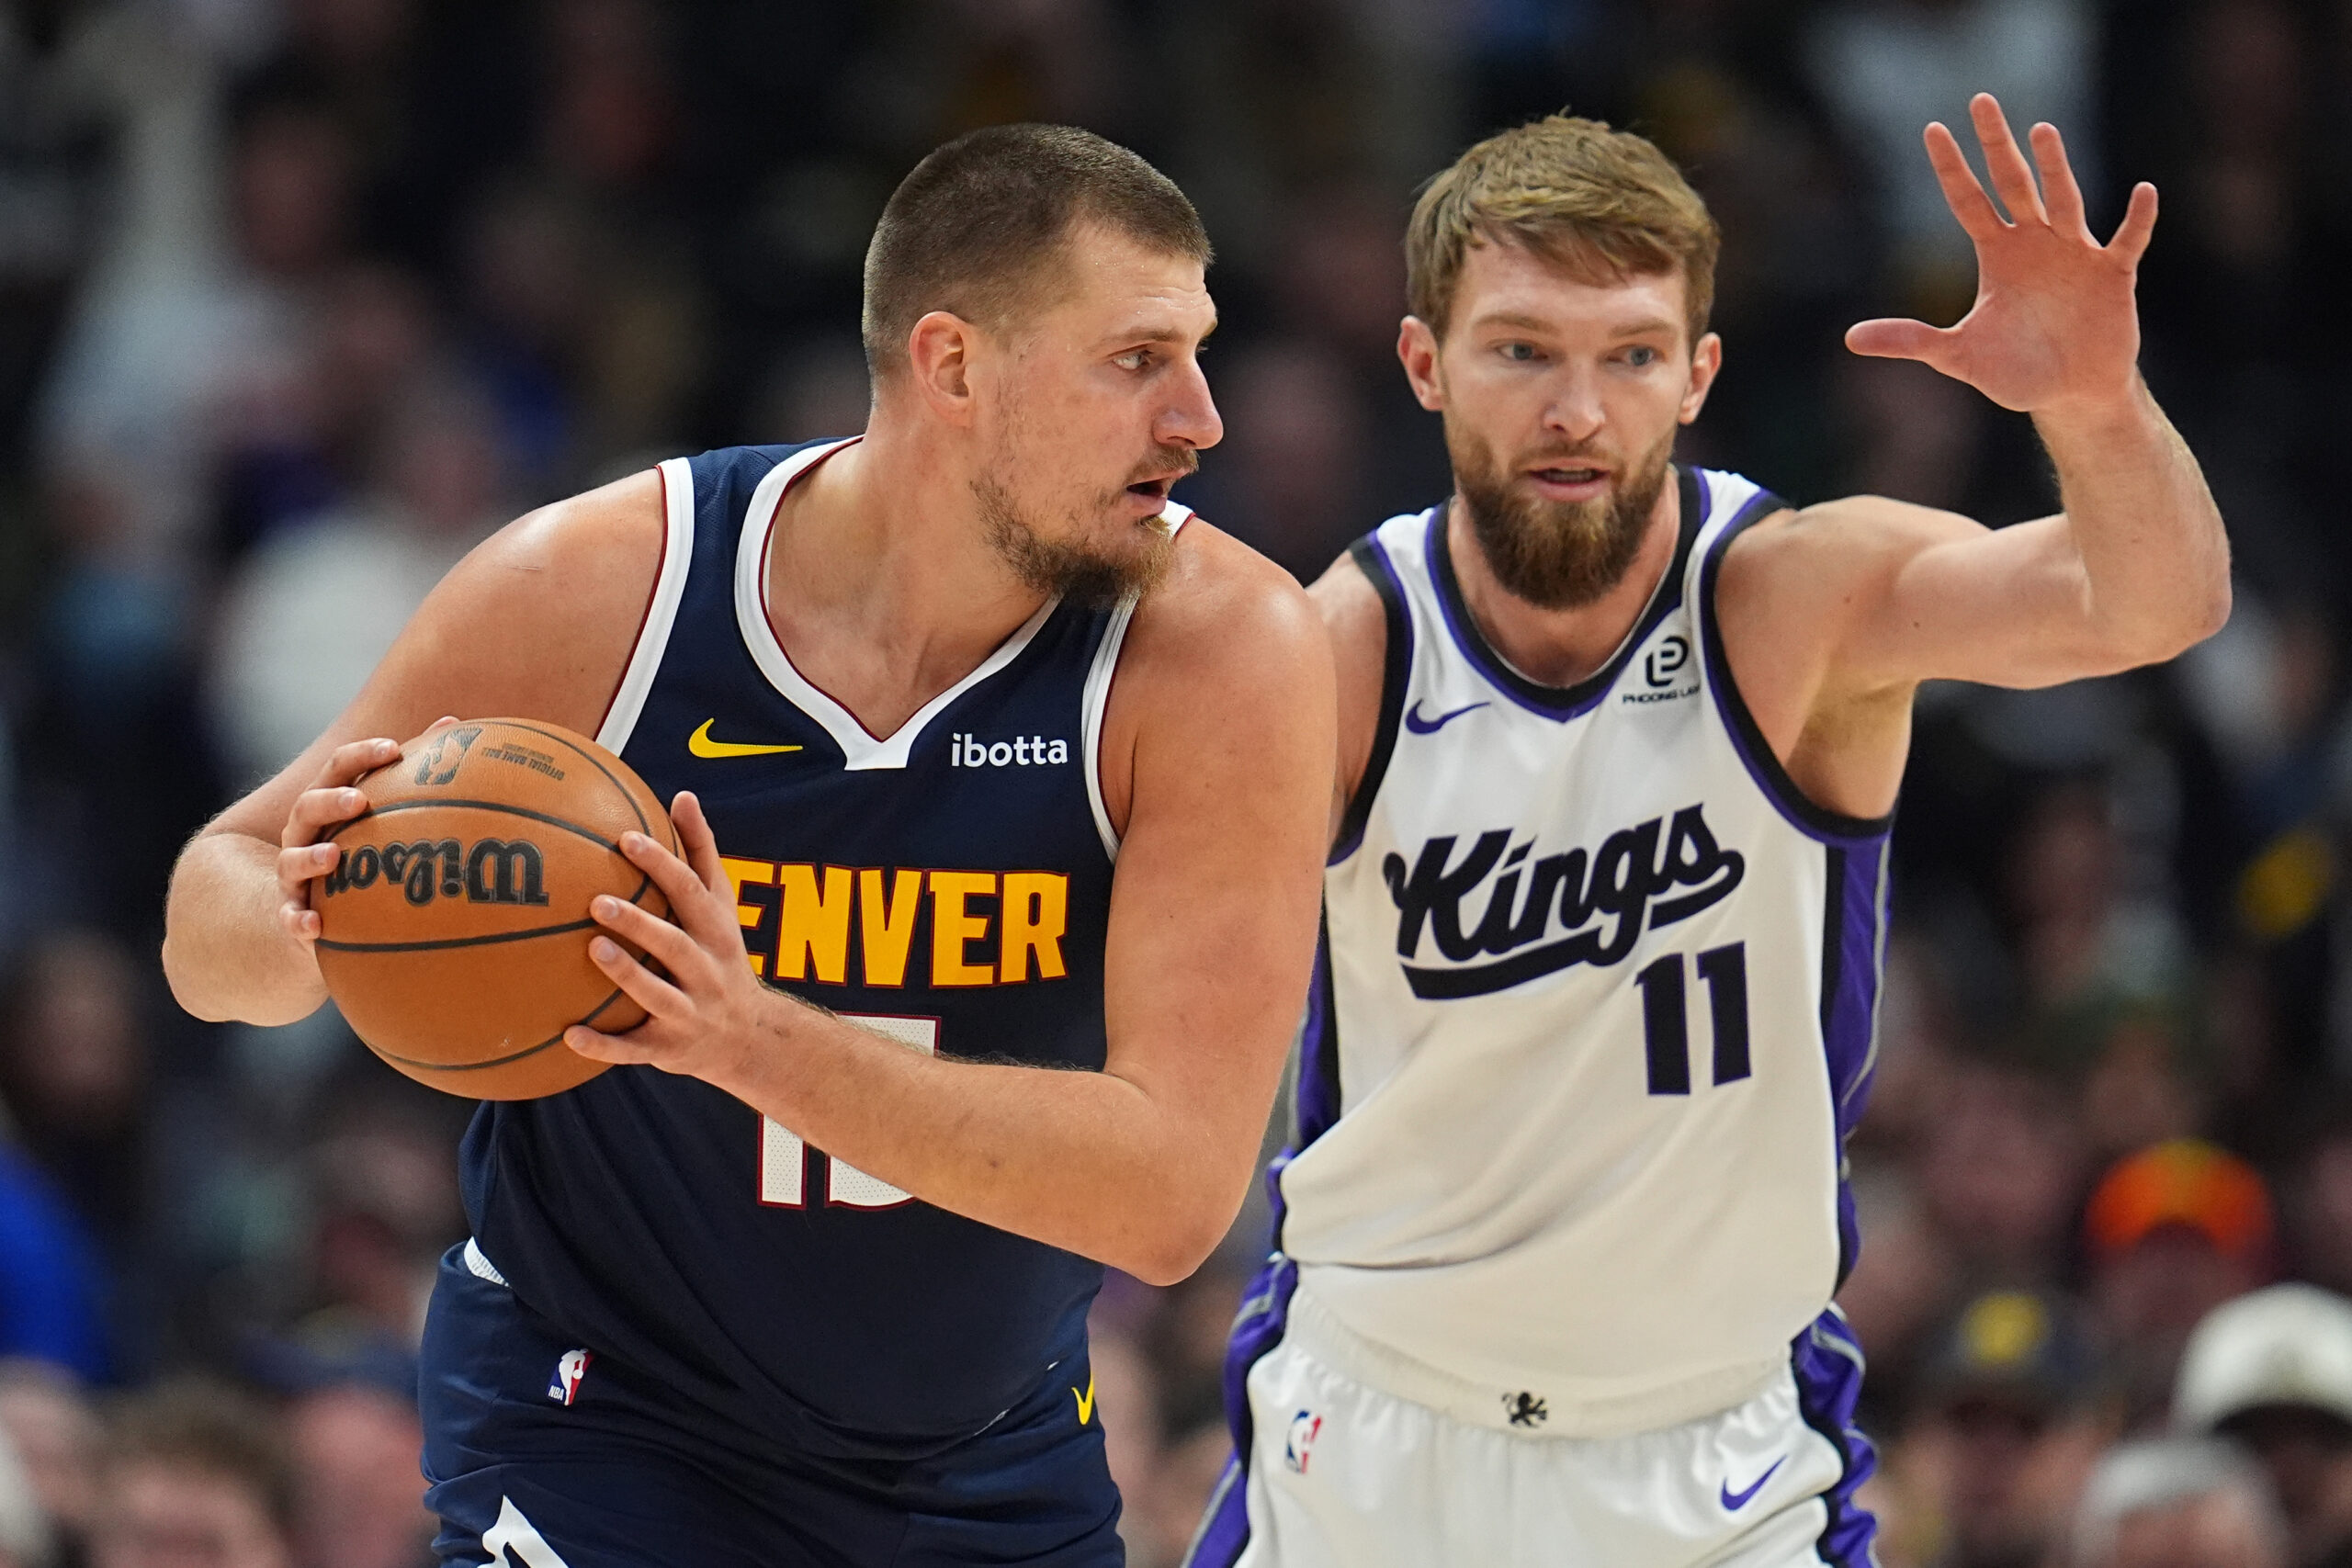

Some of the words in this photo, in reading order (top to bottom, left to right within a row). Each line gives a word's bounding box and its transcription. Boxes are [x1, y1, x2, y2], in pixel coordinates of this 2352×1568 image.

[528, 758, 566, 781] OFFICIAL
[951, 732, 1069, 767] ibotta
[324, 838, 549, 907] Wilson
[1383, 802, 1746, 999] Kings
[718, 853, 1070, 989] ENVER
[1634, 940, 1751, 1096] 11
[548, 1384, 565, 1402] NBA
